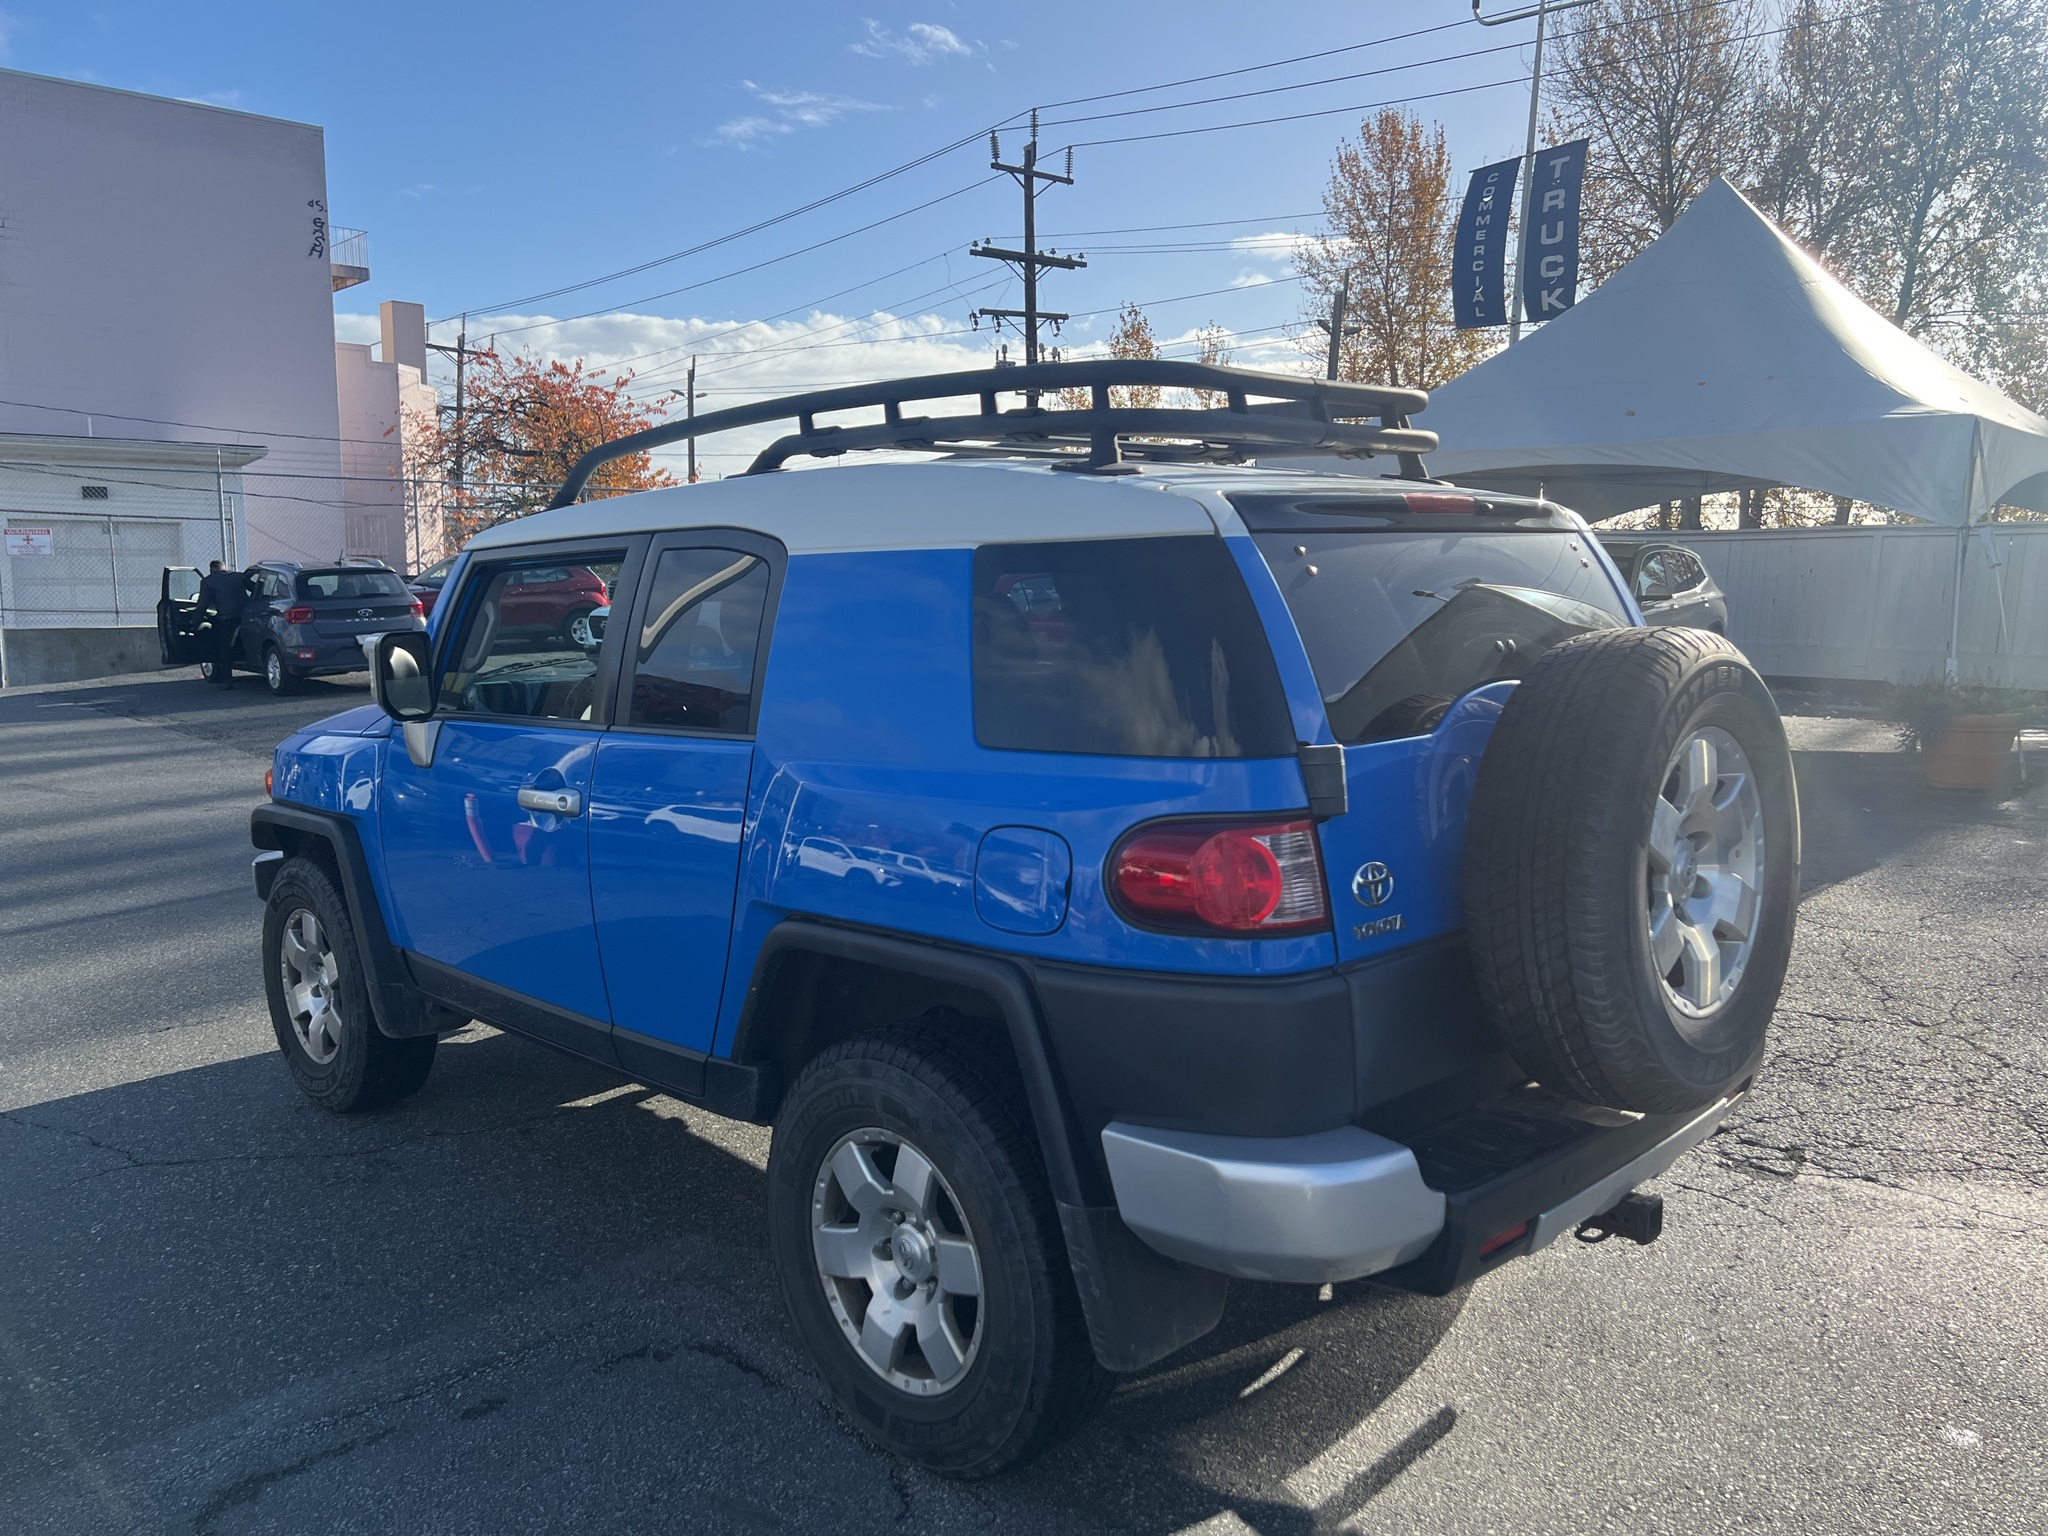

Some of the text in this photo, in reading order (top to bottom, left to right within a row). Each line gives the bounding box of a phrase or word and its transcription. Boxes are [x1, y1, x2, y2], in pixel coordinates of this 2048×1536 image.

[1472, 172, 1499, 317] COMMERCIAL
[1540, 156, 1571, 312] TRUCK
[1353, 914, 1406, 940] TOYOTA
